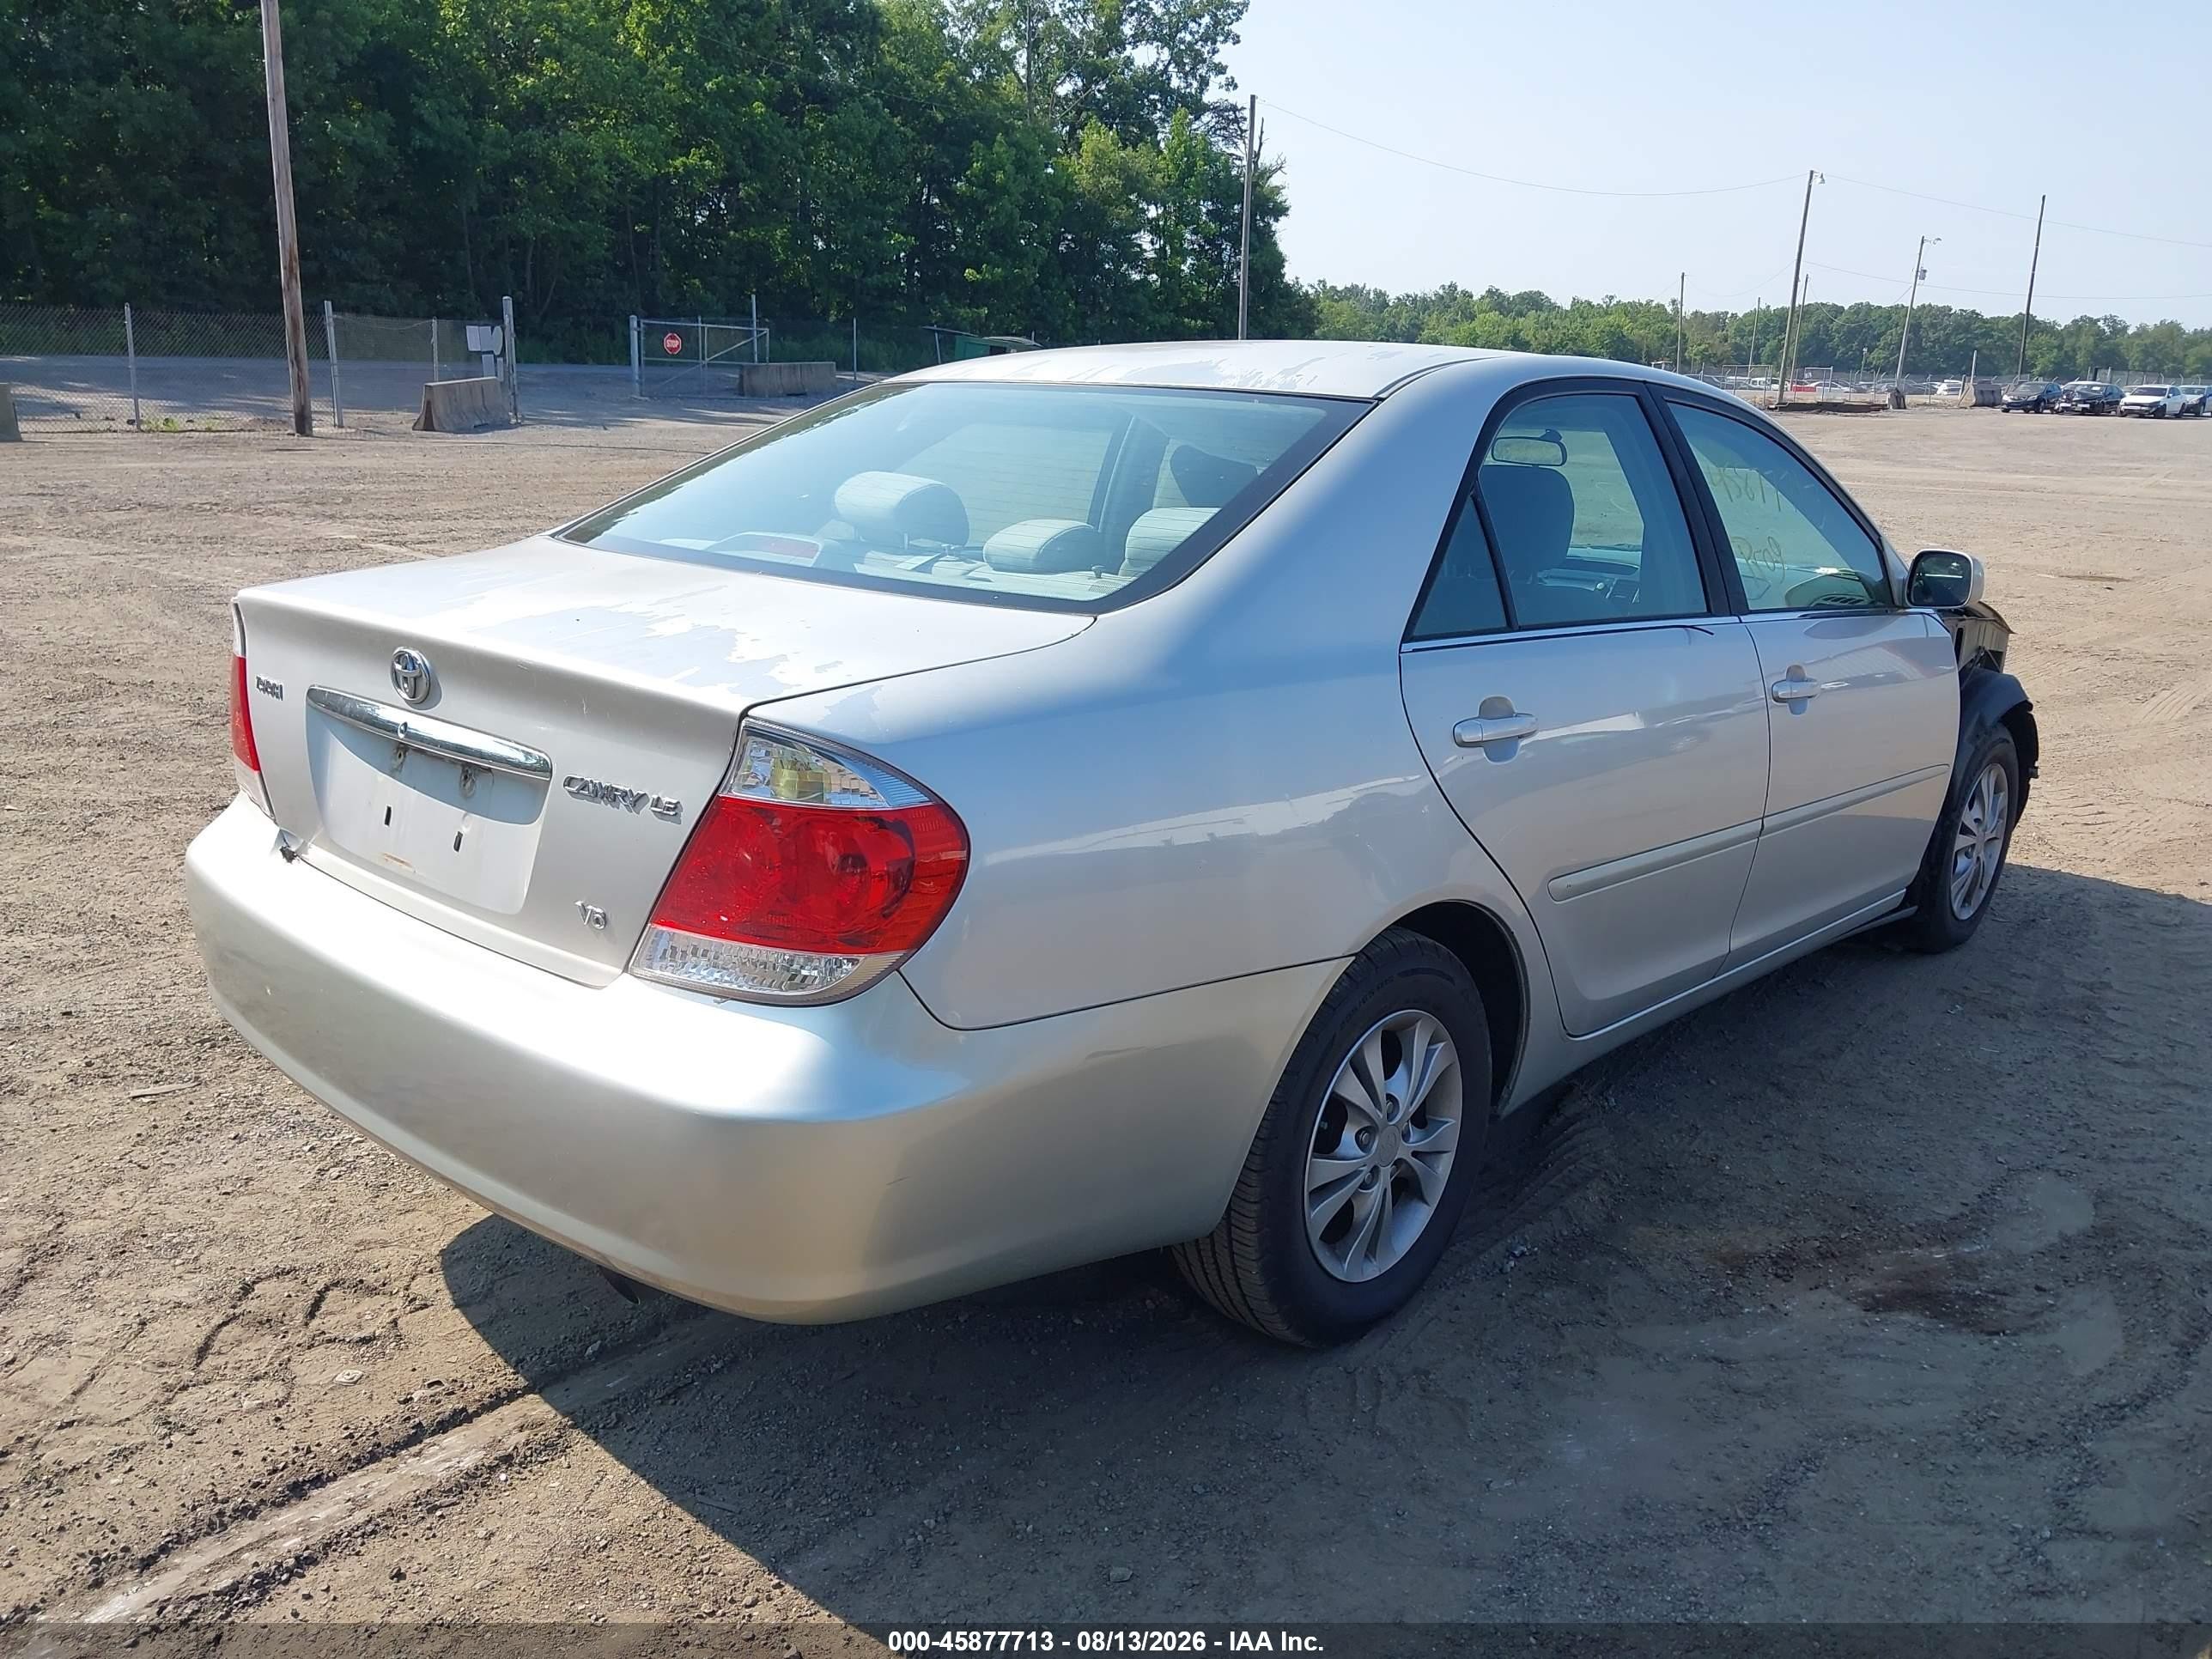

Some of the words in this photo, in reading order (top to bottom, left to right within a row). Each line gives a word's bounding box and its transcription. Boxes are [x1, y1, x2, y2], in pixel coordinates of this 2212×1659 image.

[665, 339, 680, 349] STOP
[562, 775, 649, 811] CAMRY
[649, 794, 684, 817] LE
[574, 900, 607, 930] V6
